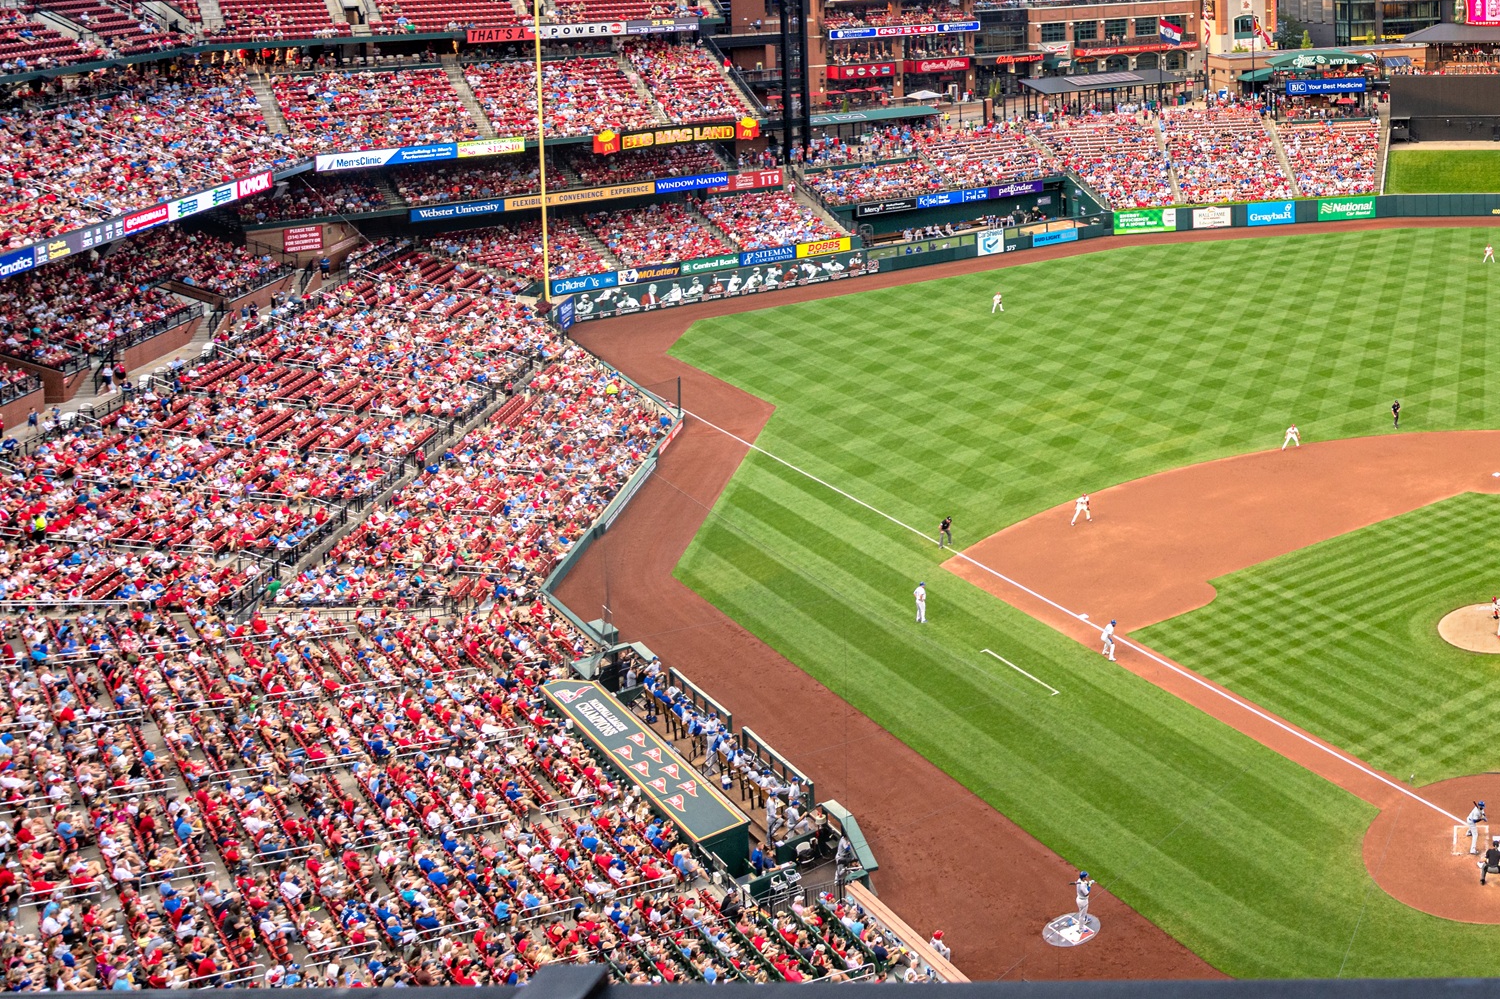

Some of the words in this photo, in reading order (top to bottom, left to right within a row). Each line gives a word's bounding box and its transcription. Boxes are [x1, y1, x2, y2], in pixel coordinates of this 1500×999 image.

[470, 28, 513, 42] THAT'S
[551, 26, 608, 36] POWER
[1084, 48, 1117, 56] Budweiser
[622, 132, 654, 148] BIG
[655, 128, 694, 144] MAC
[696, 124, 734, 141] LAND
[239, 172, 270, 197] KMOX
[656, 178, 696, 190] WINDOW
[696, 174, 728, 186] NATION
[760, 174, 780, 186] 119
[558, 190, 604, 202] CONVENIENCE
[610, 185, 650, 196] EXPERIENCE
[998, 183, 1033, 196] petfinder
[419, 208, 454, 219] Webster
[456, 202, 499, 215] University
[864, 206, 880, 214] Mercy
[1332, 202, 1371, 214] National
[126, 207, 167, 230] @CARDINALS
[977, 229, 1002, 238] CarShield
[754, 246, 793, 258] SITEMAN
[808, 240, 840, 252] DOBBS
[692, 260, 719, 270] Central
[719, 257, 739, 266] Bank
[638, 267, 680, 279] MOLottery
[575, 702, 619, 737] CHAMPIONS
